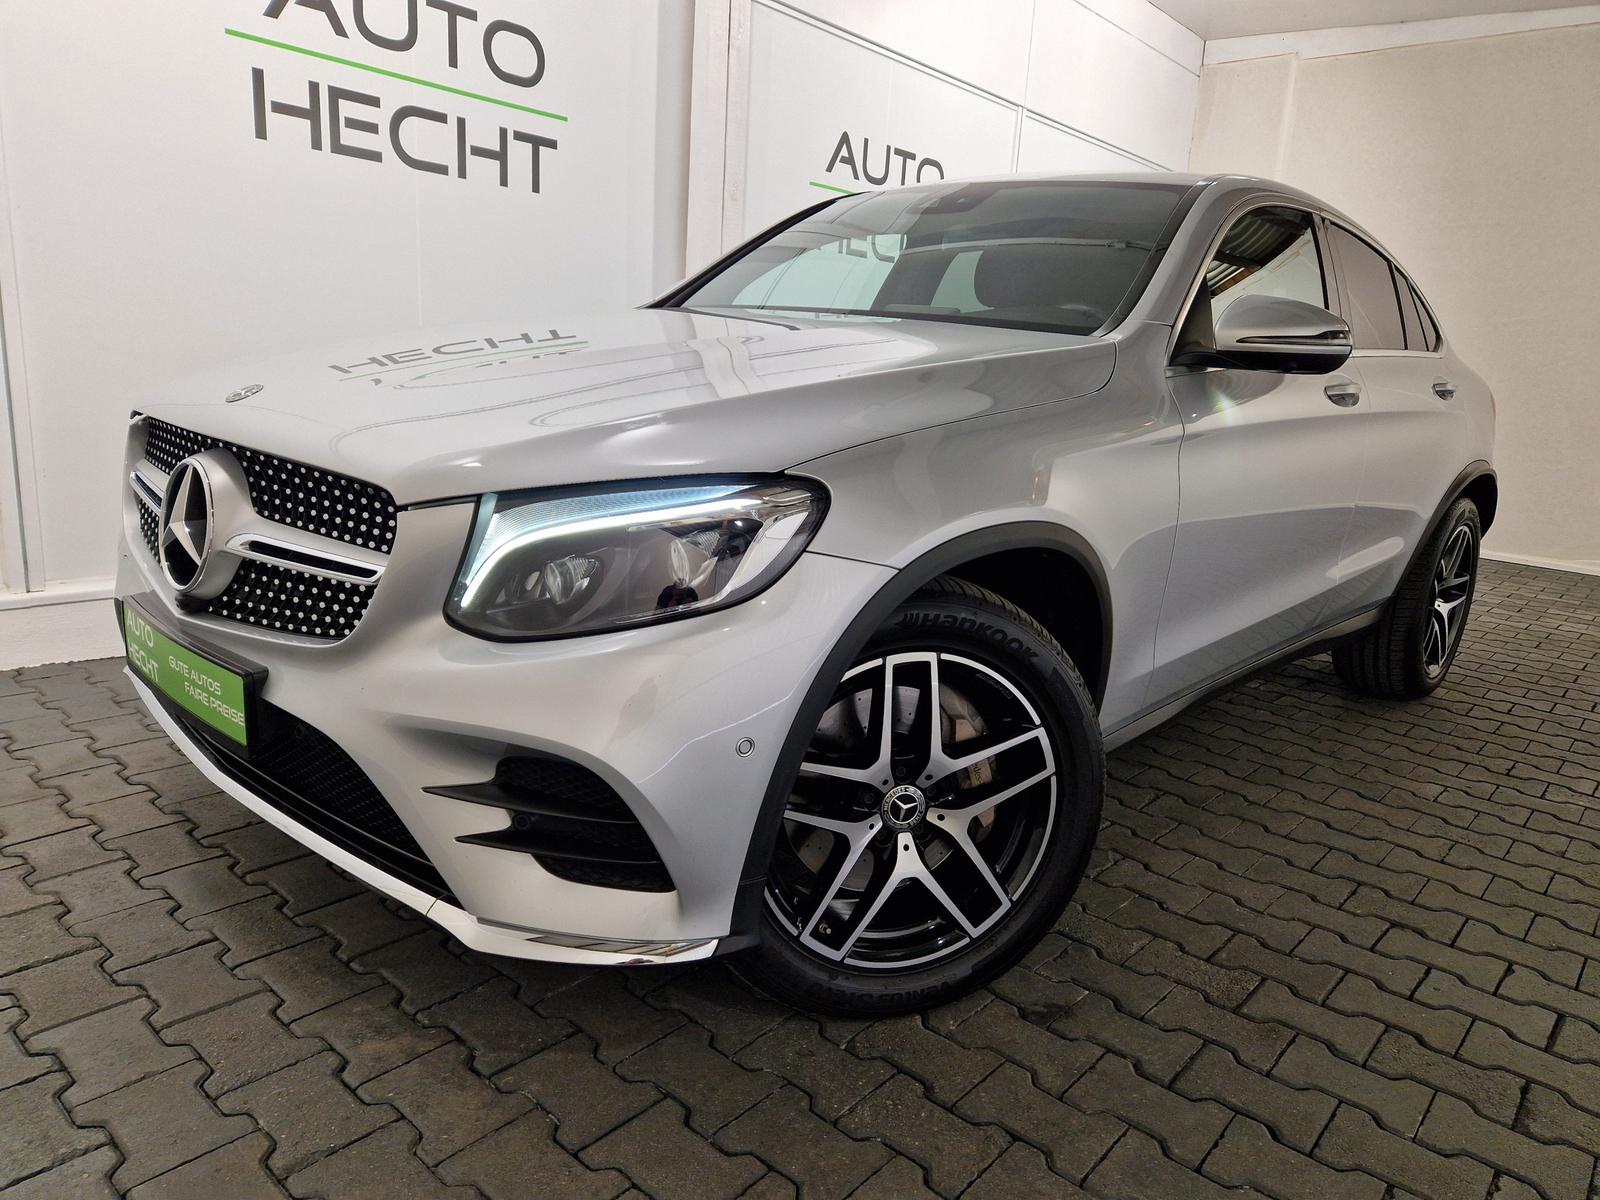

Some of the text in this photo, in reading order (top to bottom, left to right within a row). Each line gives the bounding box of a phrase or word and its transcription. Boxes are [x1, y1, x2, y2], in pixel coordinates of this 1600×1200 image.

[251, 66, 558, 194] HECHT
[127, 609, 154, 648] AUTO
[128, 639, 158, 682] HECHT
[168, 655, 221, 695] GUTE AUTOS
[184, 682, 245, 726] FAIRE PREISE
